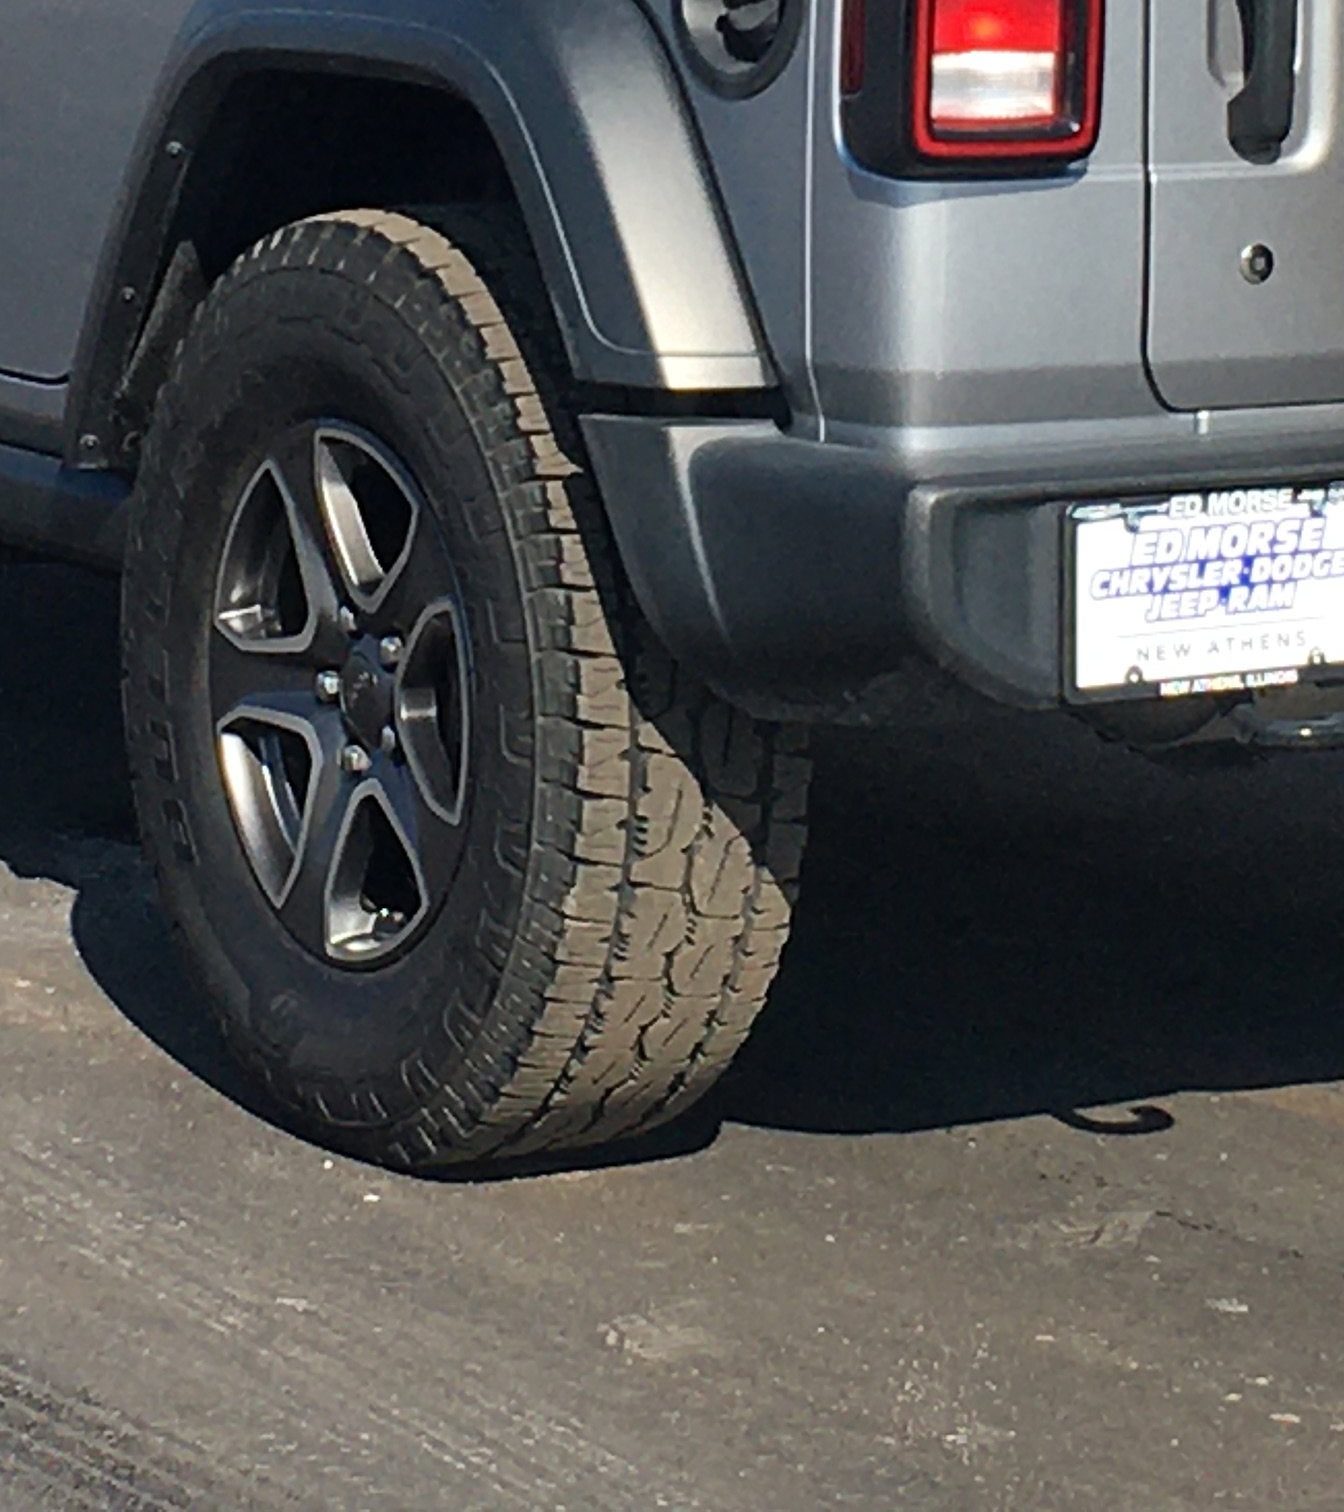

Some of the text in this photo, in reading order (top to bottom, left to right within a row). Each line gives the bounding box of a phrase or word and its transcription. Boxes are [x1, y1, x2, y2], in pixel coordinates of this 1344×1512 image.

[1167, 488, 1294, 519] ED MORSE
[1129, 517, 1327, 566] ED MORSE
[1090, 558, 1243, 601] CHRYSLER
[1144, 581, 1299, 623] JEEP RAM
[1136, 630, 1307, 663] NEW ATHENS
